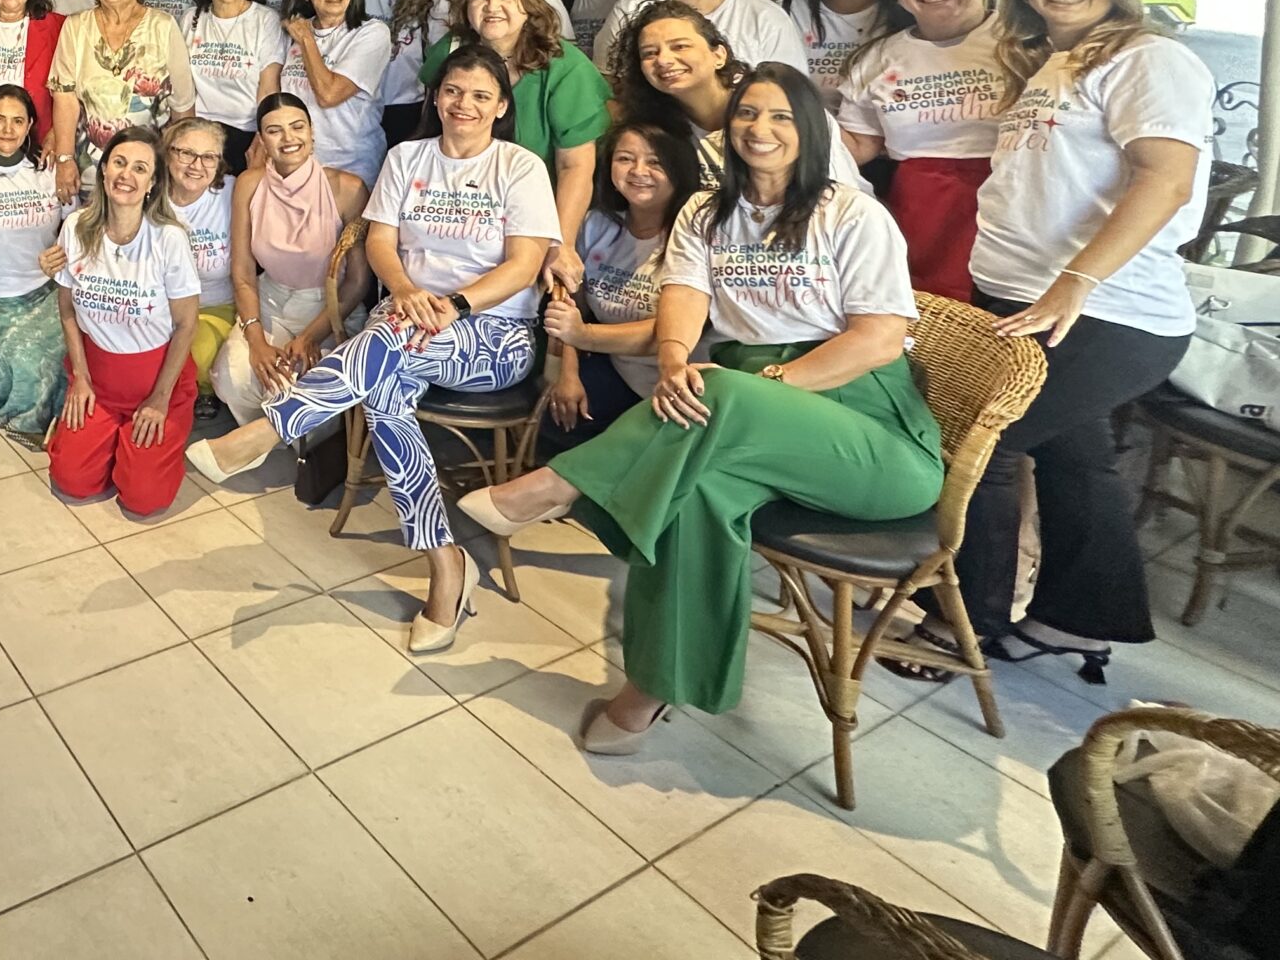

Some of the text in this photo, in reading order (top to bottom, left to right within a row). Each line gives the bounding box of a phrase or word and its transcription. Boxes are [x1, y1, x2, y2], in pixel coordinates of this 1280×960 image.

[881, 91, 998, 113] SÃO COISAS DE
[401, 210, 494, 225] SÃO COISAS DE
[413, 204, 491, 217] GEOCIÊNCIAS
[207, 249, 217, 257] DE
[821, 255, 830, 265] &
[712, 261, 806, 277] GEOCIÊNCIAS
[723, 277, 777, 287] COISAS
[790, 276, 812, 287] DE
[75, 288, 139, 307] GEOCIÊNCIAS
[150, 289, 157, 297] &
[82, 299, 142, 315] COISAS DE
[596, 290, 653, 313] COISAS DE
